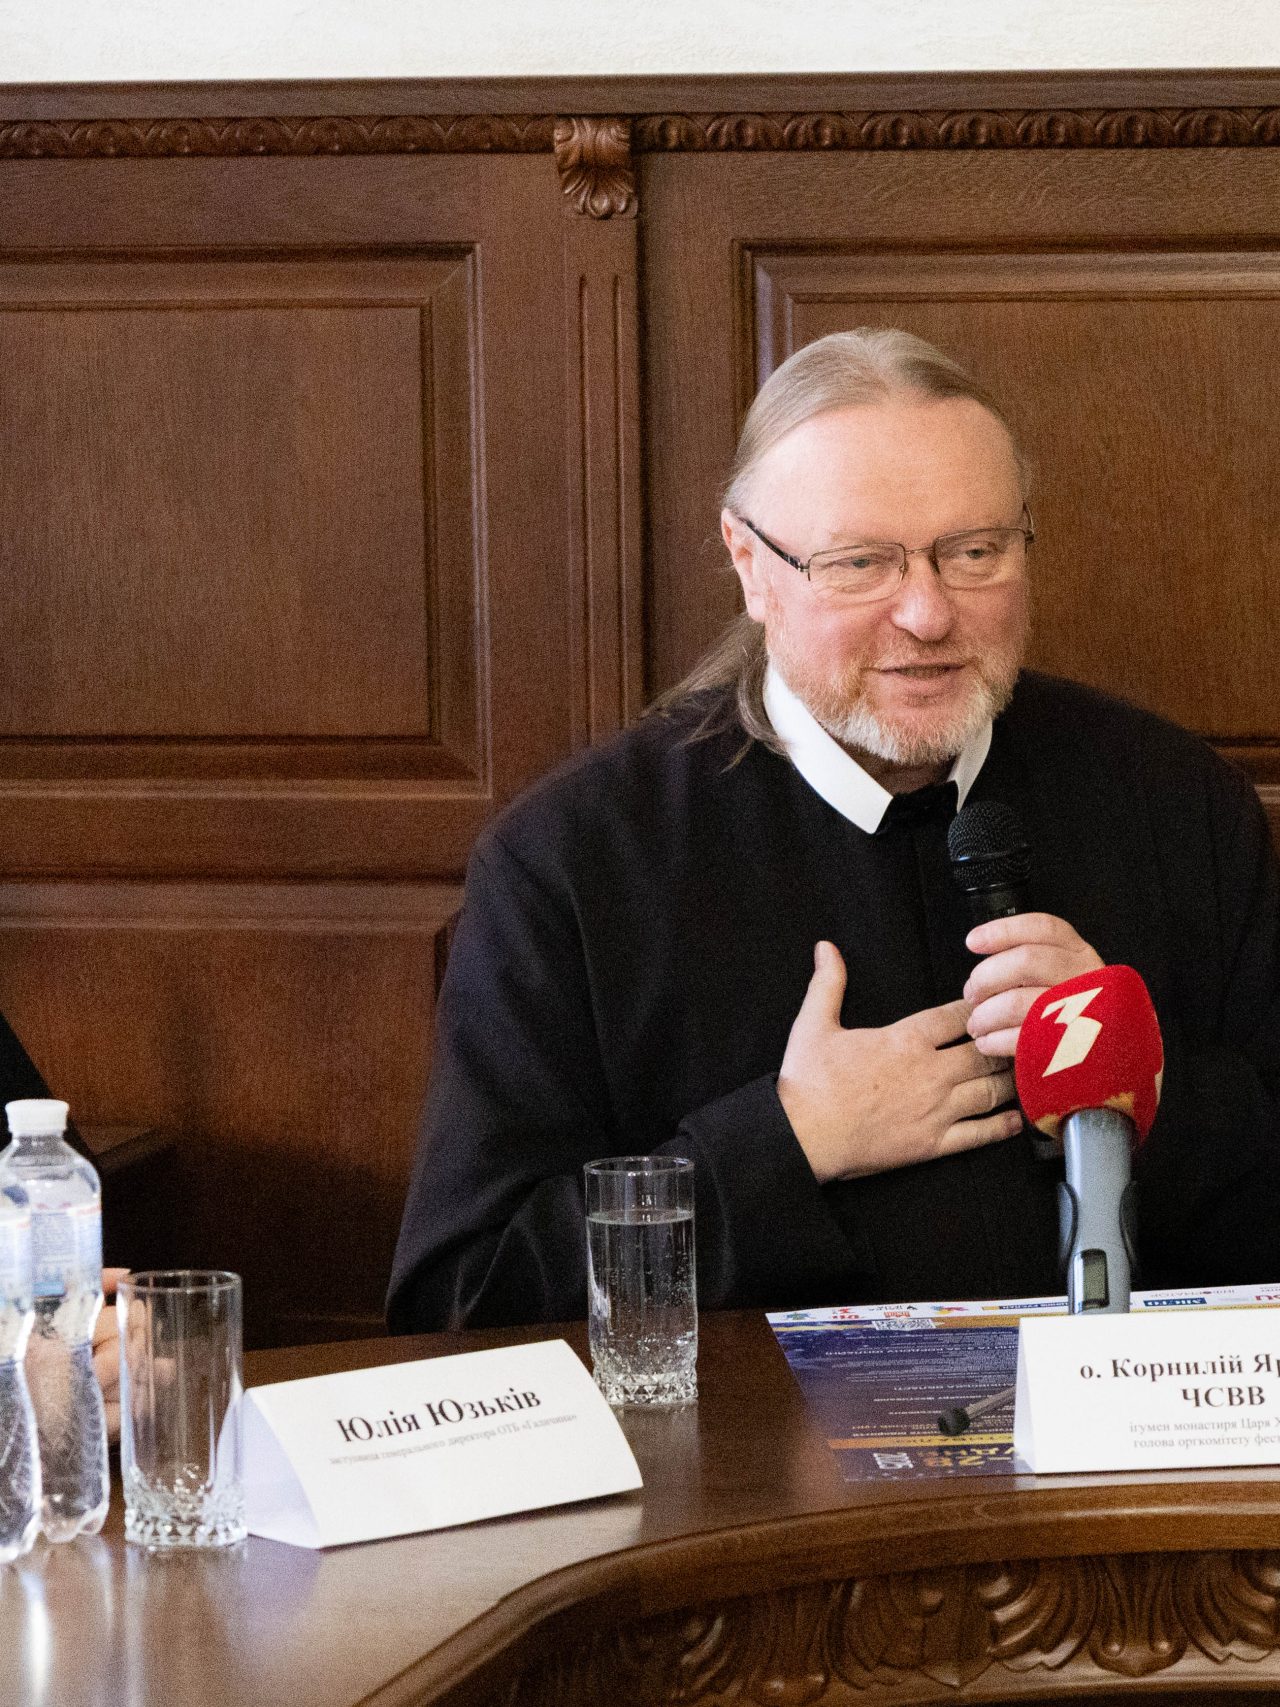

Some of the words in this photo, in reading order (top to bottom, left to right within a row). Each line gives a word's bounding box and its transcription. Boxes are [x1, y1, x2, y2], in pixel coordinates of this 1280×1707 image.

[1079, 1364, 1103, 1380] о.
[1111, 1355, 1244, 1383] Корнилій
[1180, 1385, 1267, 1409] ЧСВВ
[334, 1410, 422, 1443] Юлія
[425, 1387, 542, 1427] Юзьків
[1129, 1421, 1171, 1436] ігумен
[1173, 1419, 1238, 1434] монастиря
[1241, 1416, 1273, 1432] Царя
[1132, 1438, 1175, 1449] голова
[1177, 1434, 1250, 1450] оргкомітету
